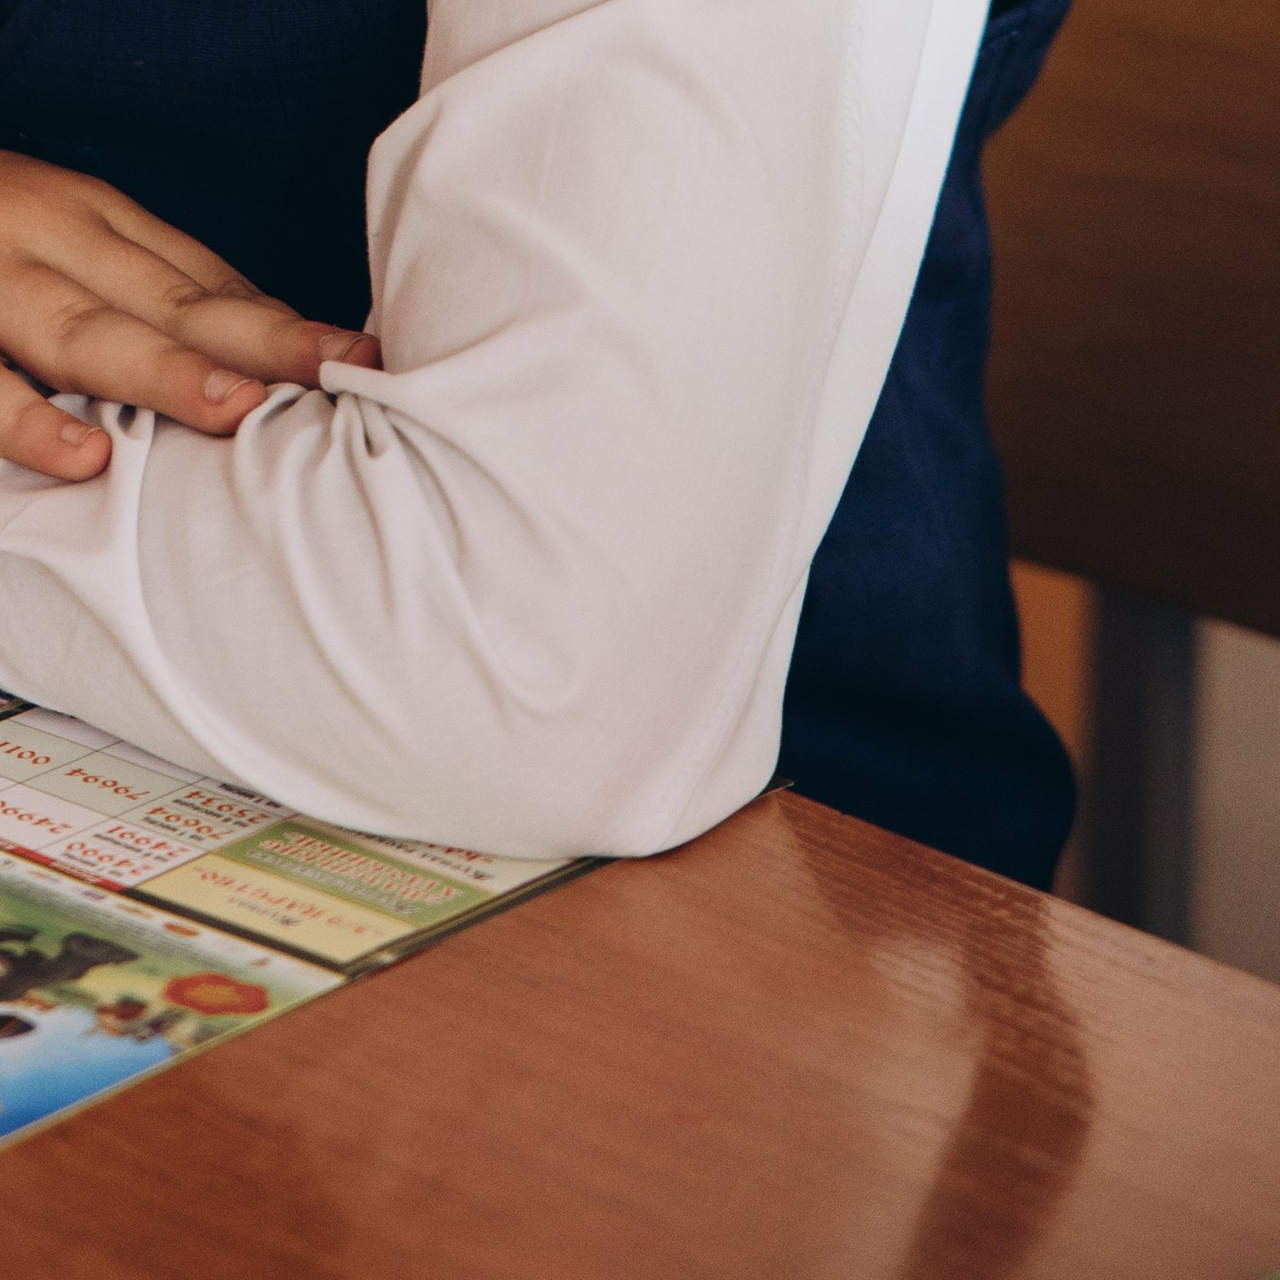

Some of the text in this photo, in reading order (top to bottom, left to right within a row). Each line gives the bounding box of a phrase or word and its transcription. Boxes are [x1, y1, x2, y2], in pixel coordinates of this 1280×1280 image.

[64, 768, 150, 800] 79694
[144, 806, 234, 840] 79694
[182, 790, 270, 824] 25934
[64, 841, 152, 876] 24990
